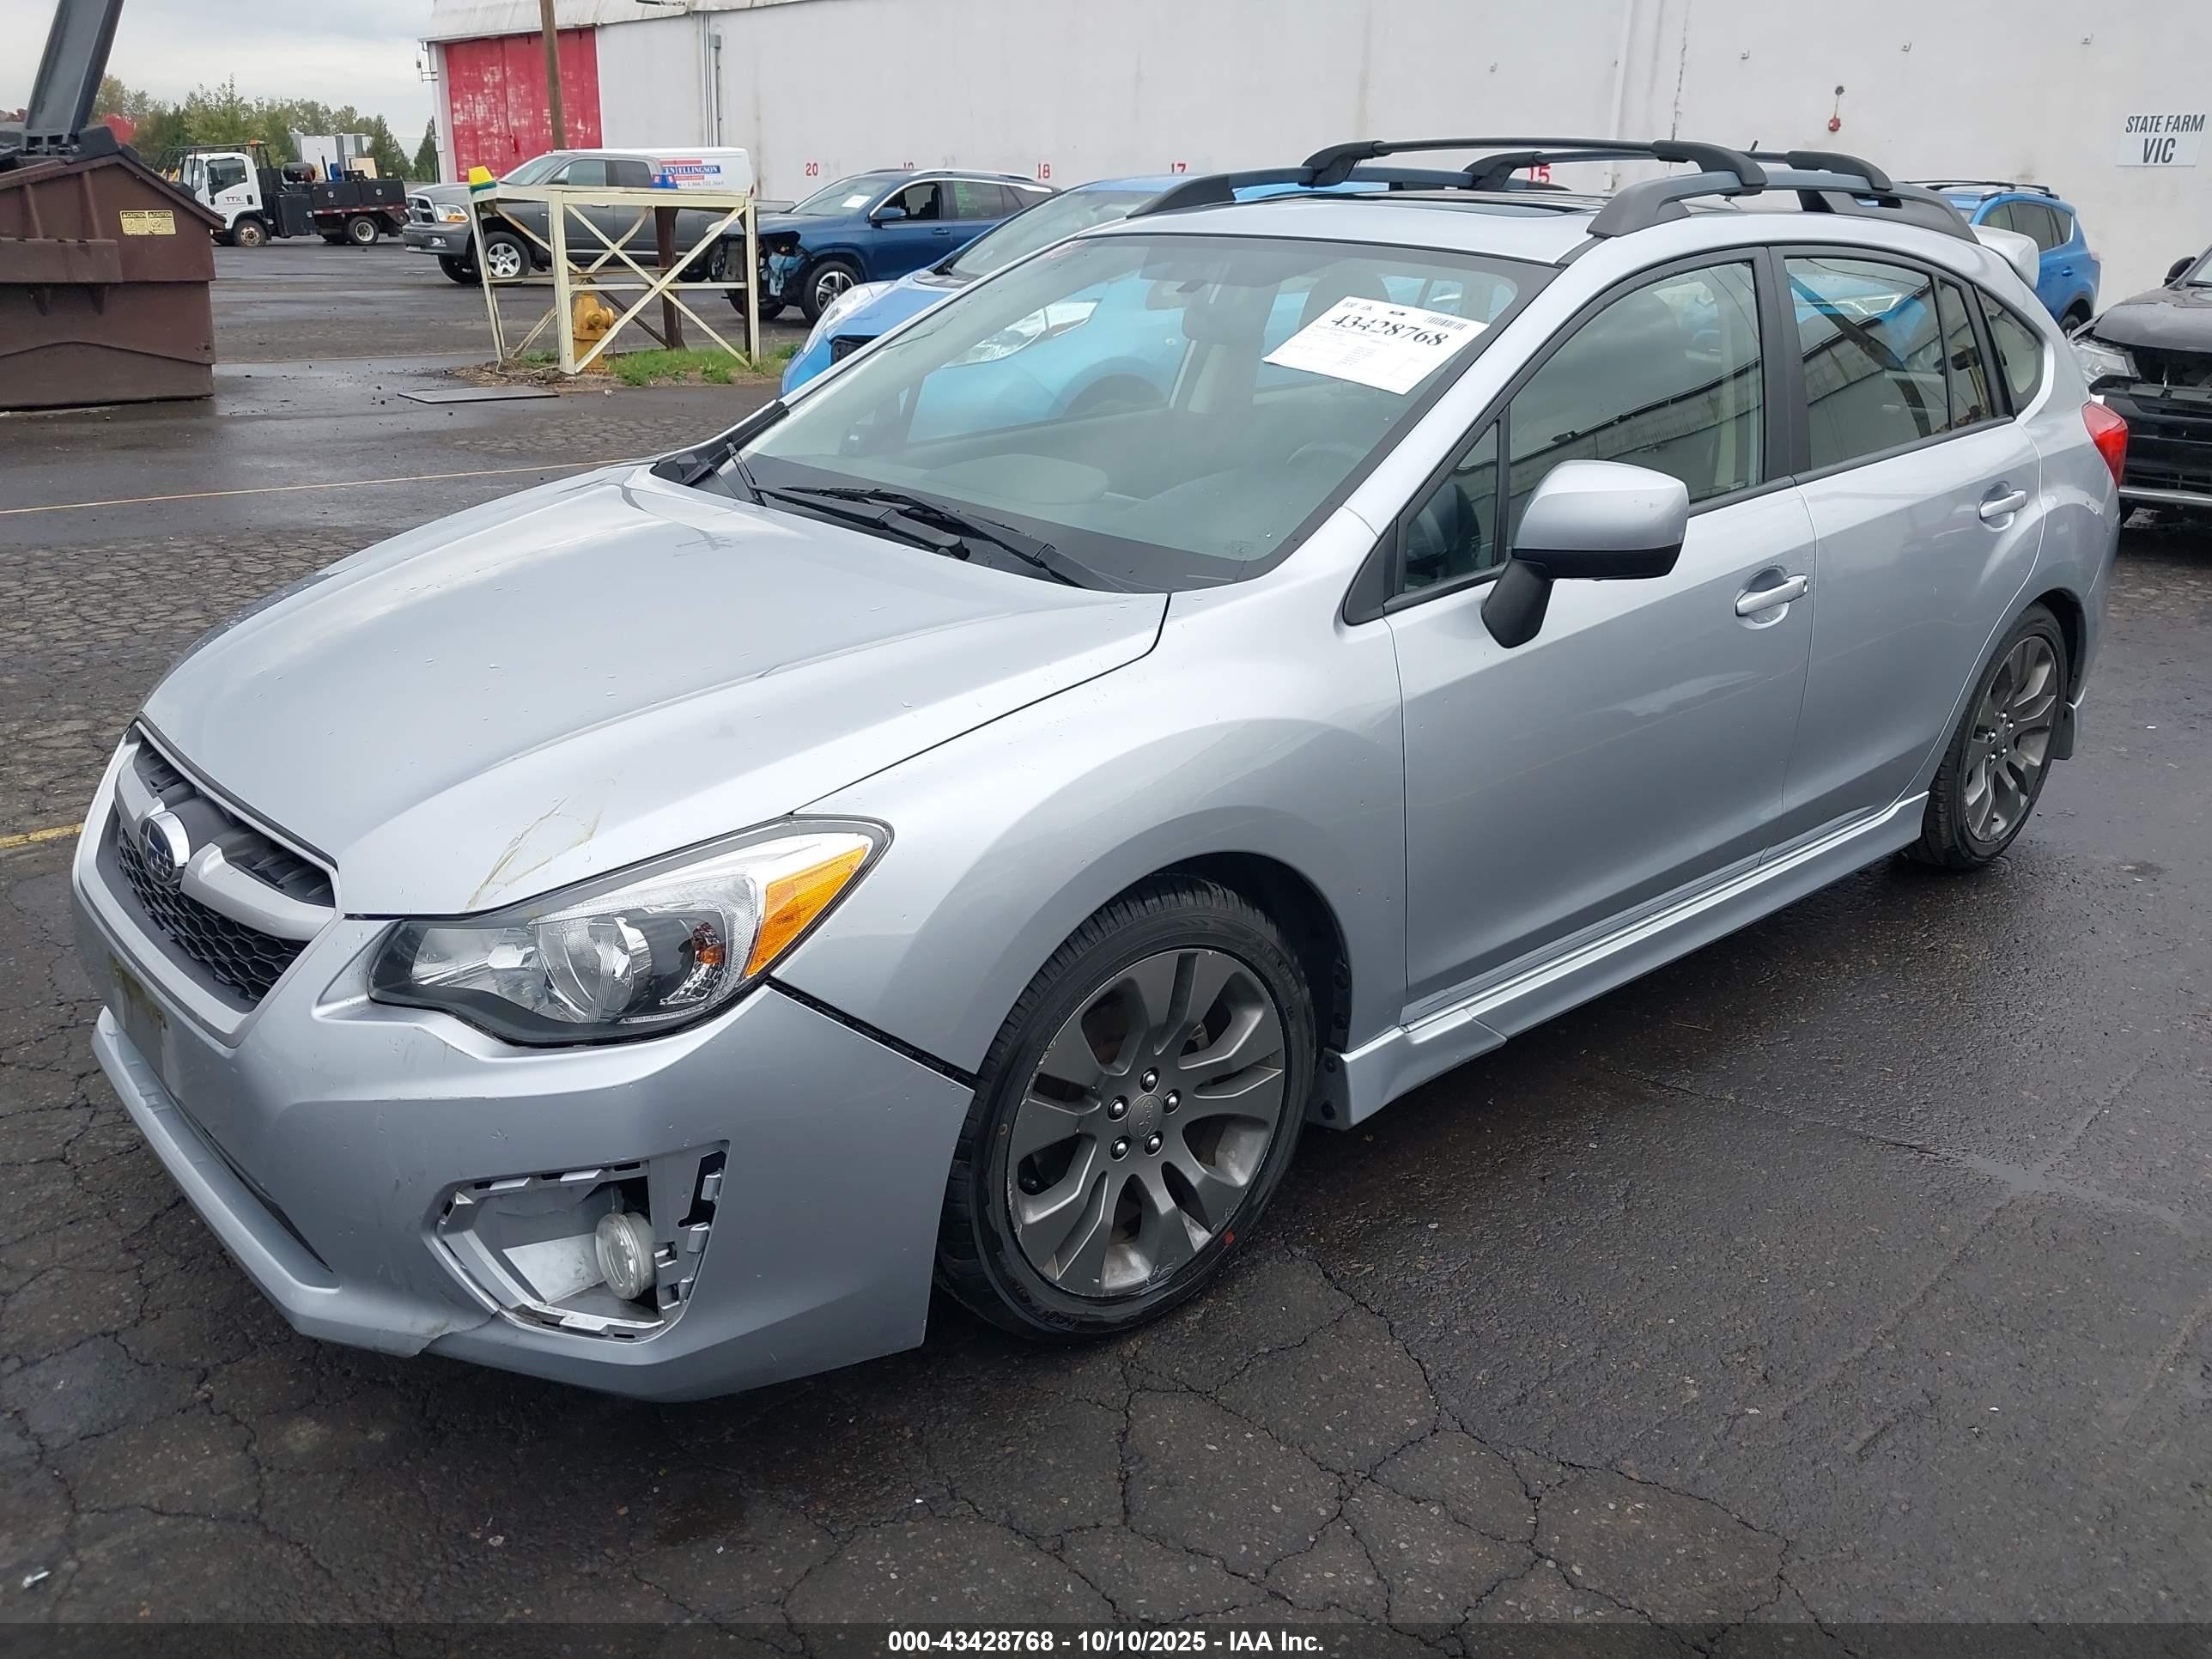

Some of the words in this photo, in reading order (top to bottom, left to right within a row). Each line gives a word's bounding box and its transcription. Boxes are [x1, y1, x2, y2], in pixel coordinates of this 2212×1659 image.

[2125, 115, 2163, 133] STATE
[2164, 113, 2206, 133] FARM
[2142, 137, 2177, 164] VIC
[805, 162, 818, 176] 20
[1037, 163, 1051, 179] 18
[1171, 163, 1187, 173] 17
[1530, 165, 1551, 183] 15
[1331, 314, 1449, 346] 43428768
